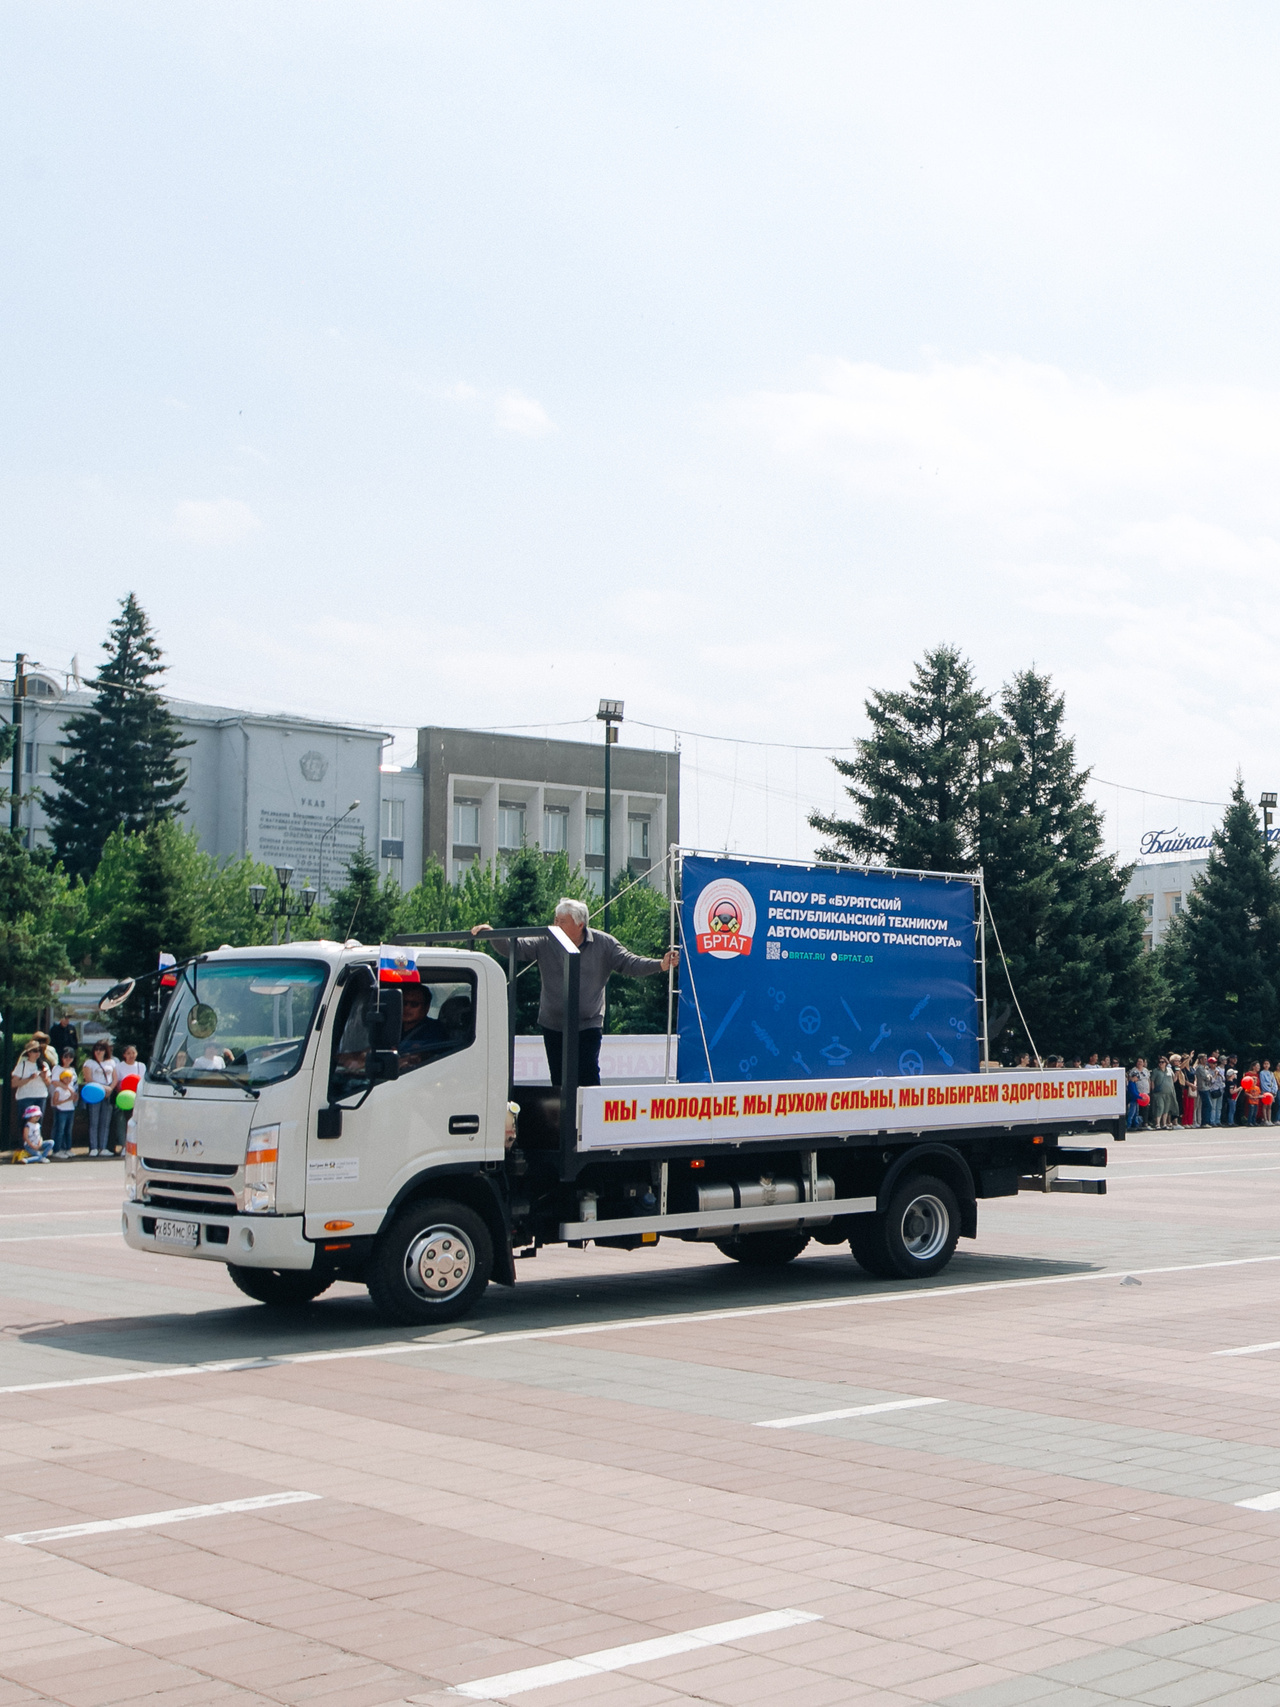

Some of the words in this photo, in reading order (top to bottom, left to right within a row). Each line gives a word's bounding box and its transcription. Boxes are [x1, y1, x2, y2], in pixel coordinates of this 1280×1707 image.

[769, 889, 808, 904] ГАПОУ
[811, 893, 826, 905] РБ
[828, 895, 902, 911] «БУРЯТСКИЙ
[768, 907, 886, 927] РЕСПУБЛИКАНСКИЙ
[888, 916, 948, 930] ТЕХНИКУМ
[703, 934, 747, 950] БРТАТ
[767, 926, 881, 943] АВТОМОБИЛЬНОГО
[883, 933, 962, 948] ТРАНСПОРТА»
[789, 951, 826, 961] BRTAT.RU
[604, 1099, 637, 1122] МЫ
[650, 1095, 739, 1120] МОЛОДЫЕ,
[742, 1094, 773, 1115] МЫ
[775, 1091, 828, 1116] ДУХОМ
[830, 1089, 896, 1111] СИЛЬНЫ,
[898, 1087, 925, 1107] МЫ
[927, 1084, 999, 1106] ВЫБИРАЕМ
[1001, 1081, 1065, 1104] ЗДОРОВЬЕ
[1067, 1079, 1118, 1098] СТРАНЫ!
